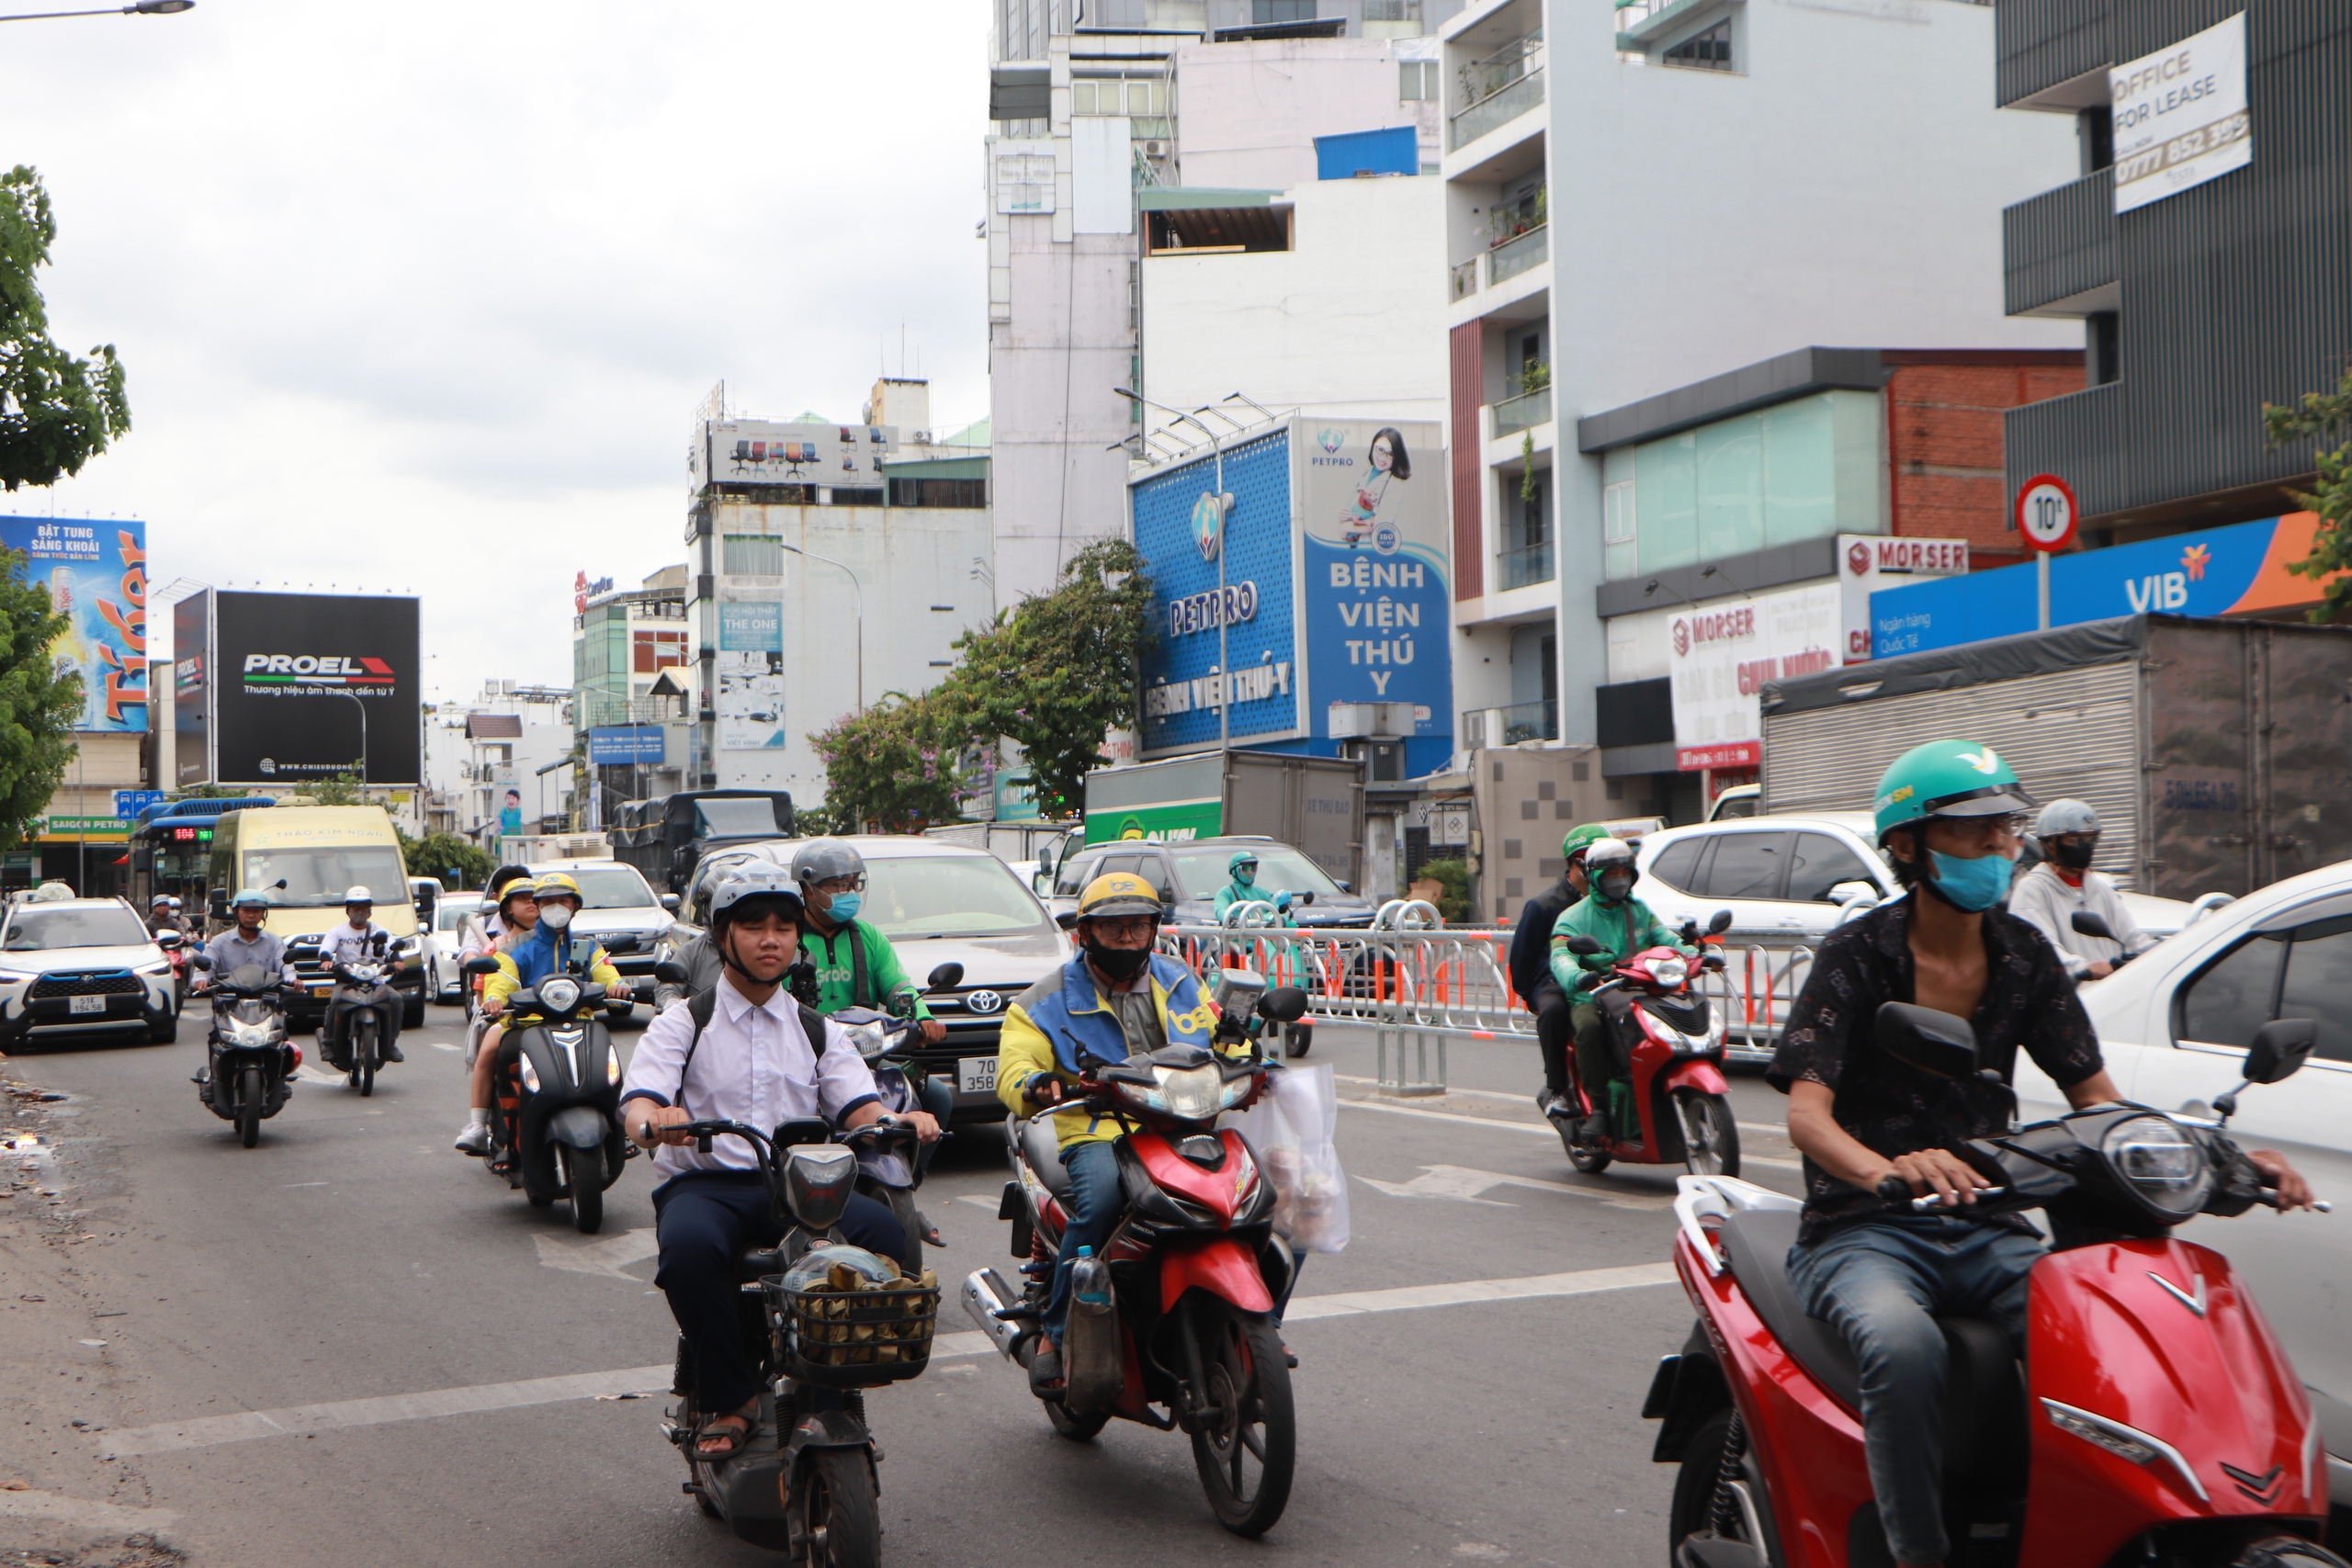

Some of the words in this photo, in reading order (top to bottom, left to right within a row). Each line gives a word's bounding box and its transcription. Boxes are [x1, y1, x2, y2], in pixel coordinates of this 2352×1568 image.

[2114, 50, 2191, 102] OFFICE
[2116, 103, 2150, 132] FOR
[2155, 73, 2216, 116] LEASE
[2115, 145, 2163, 183] 0777
[2167, 131, 2205, 164] 852
[1312, 457, 1353, 466] PETPRO
[38, 524, 60, 538] BẬT
[63, 526, 94, 537] TUNG
[65, 539, 99, 552] KHOÁI
[1878, 542, 1965, 568] MORSER
[1330, 556, 1424, 594] BỆNH
[2126, 571, 2188, 613] VIB
[1170, 581, 1258, 637] PETPRO
[1338, 595, 1419, 634] VIỆN
[724, 619, 748, 628] THE
[752, 619, 777, 628] ONE
[1692, 606, 1755, 643] MORSER
[1879, 617, 1905, 635] Ngân
[1906, 613, 1930, 628] hàng
[1345, 632, 1415, 664] THÚ
[1881, 636, 1905, 653] Quốc
[1906, 632, 1918, 648] Tế
[243, 654, 363, 674] PROEL
[244, 685, 281, 695] Thương
[283, 686, 304, 696] hiệu
[356, 686, 375, 695] đến
[1370, 671, 1392, 695] Y
[1307, 798, 1317, 813] XE
[52, 820, 90, 829] SAIGON
[1567, 837, 1587, 847] Grab
[1109, 880, 1136, 893] be
[816, 967, 852, 983] Grab
[1168, 1007, 1207, 1034] be
[1182, 1134, 1216, 1143] HONDA
[1130, 1222, 1156, 1236] HONDA
